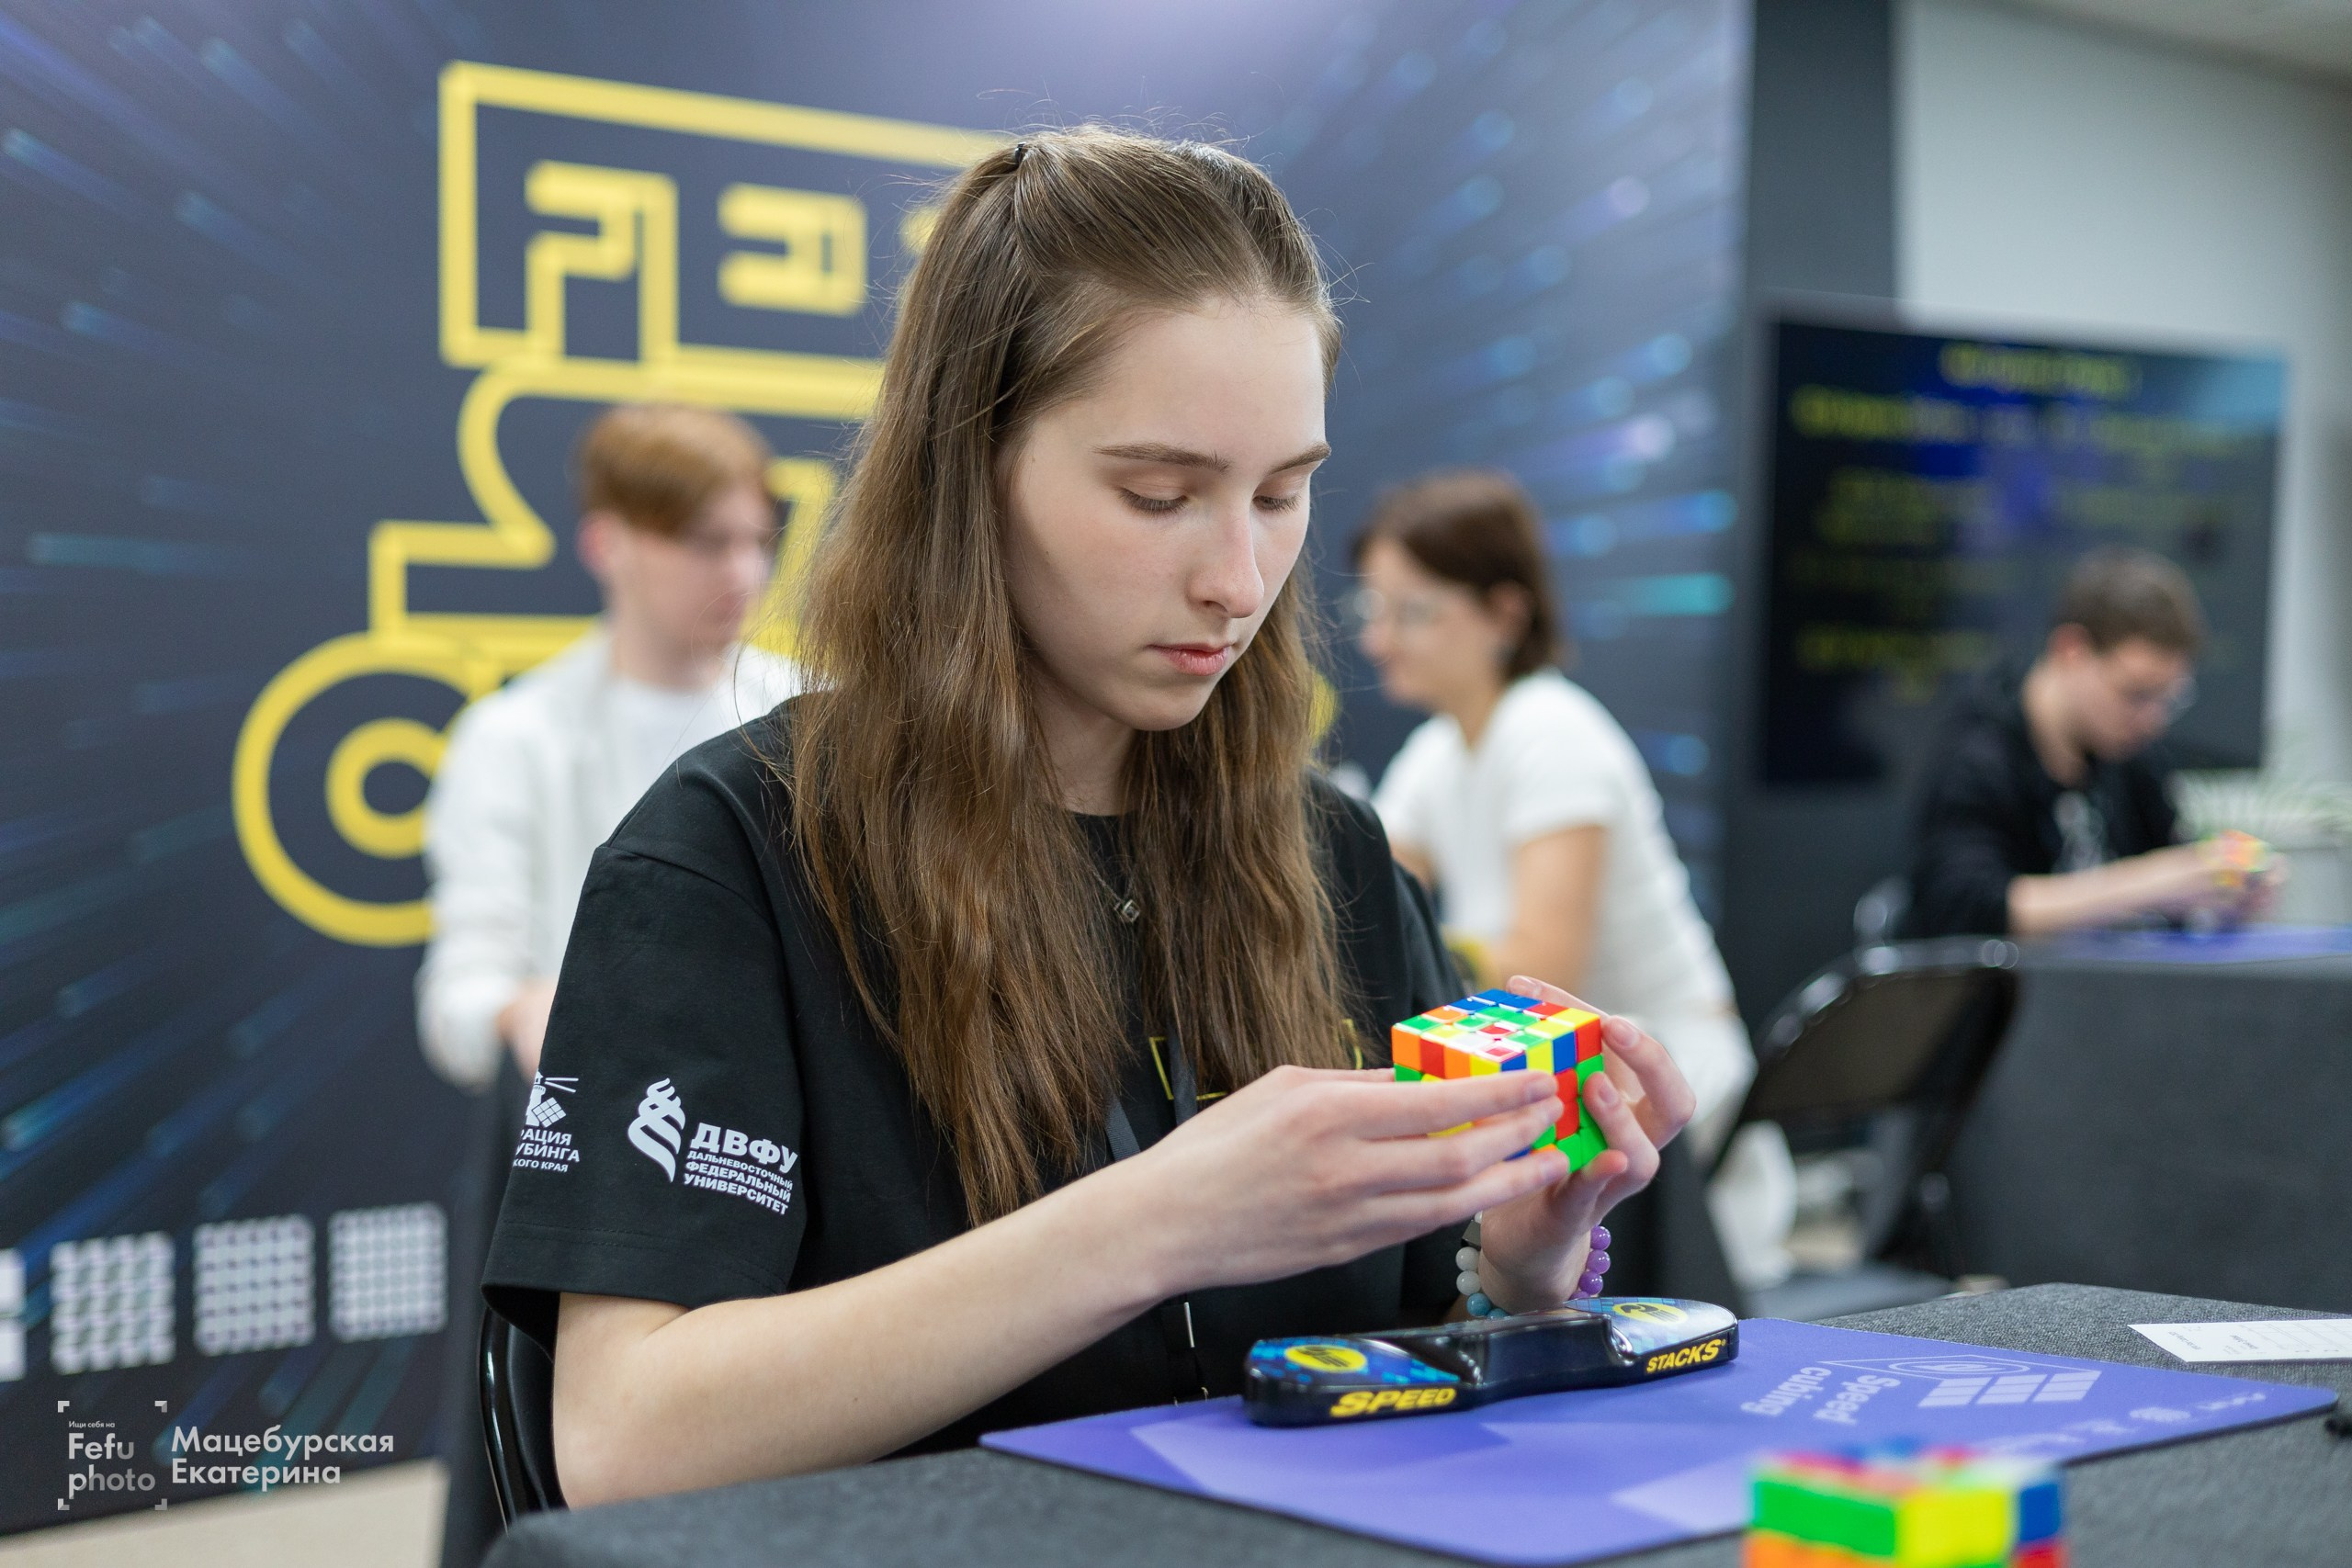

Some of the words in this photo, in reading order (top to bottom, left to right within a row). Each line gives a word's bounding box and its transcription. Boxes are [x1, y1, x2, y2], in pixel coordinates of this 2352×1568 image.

[541, 1161, 569, 1173] КРАЯ
[690, 1122, 797, 1174] ДВФУ
[685, 1161, 791, 1202] ФЕДЕРАЛЬНЫЙ
[687, 1150, 793, 1190] ДАЛЬНЕВОСТОЧНЫЙ
[684, 1173, 788, 1215] УНИВЕРСИТЕТ
[1329, 1387, 1456, 1418] SPEED
[1740, 1366, 1832, 1417] cubing
[1813, 1374, 1901, 1425] Speed
